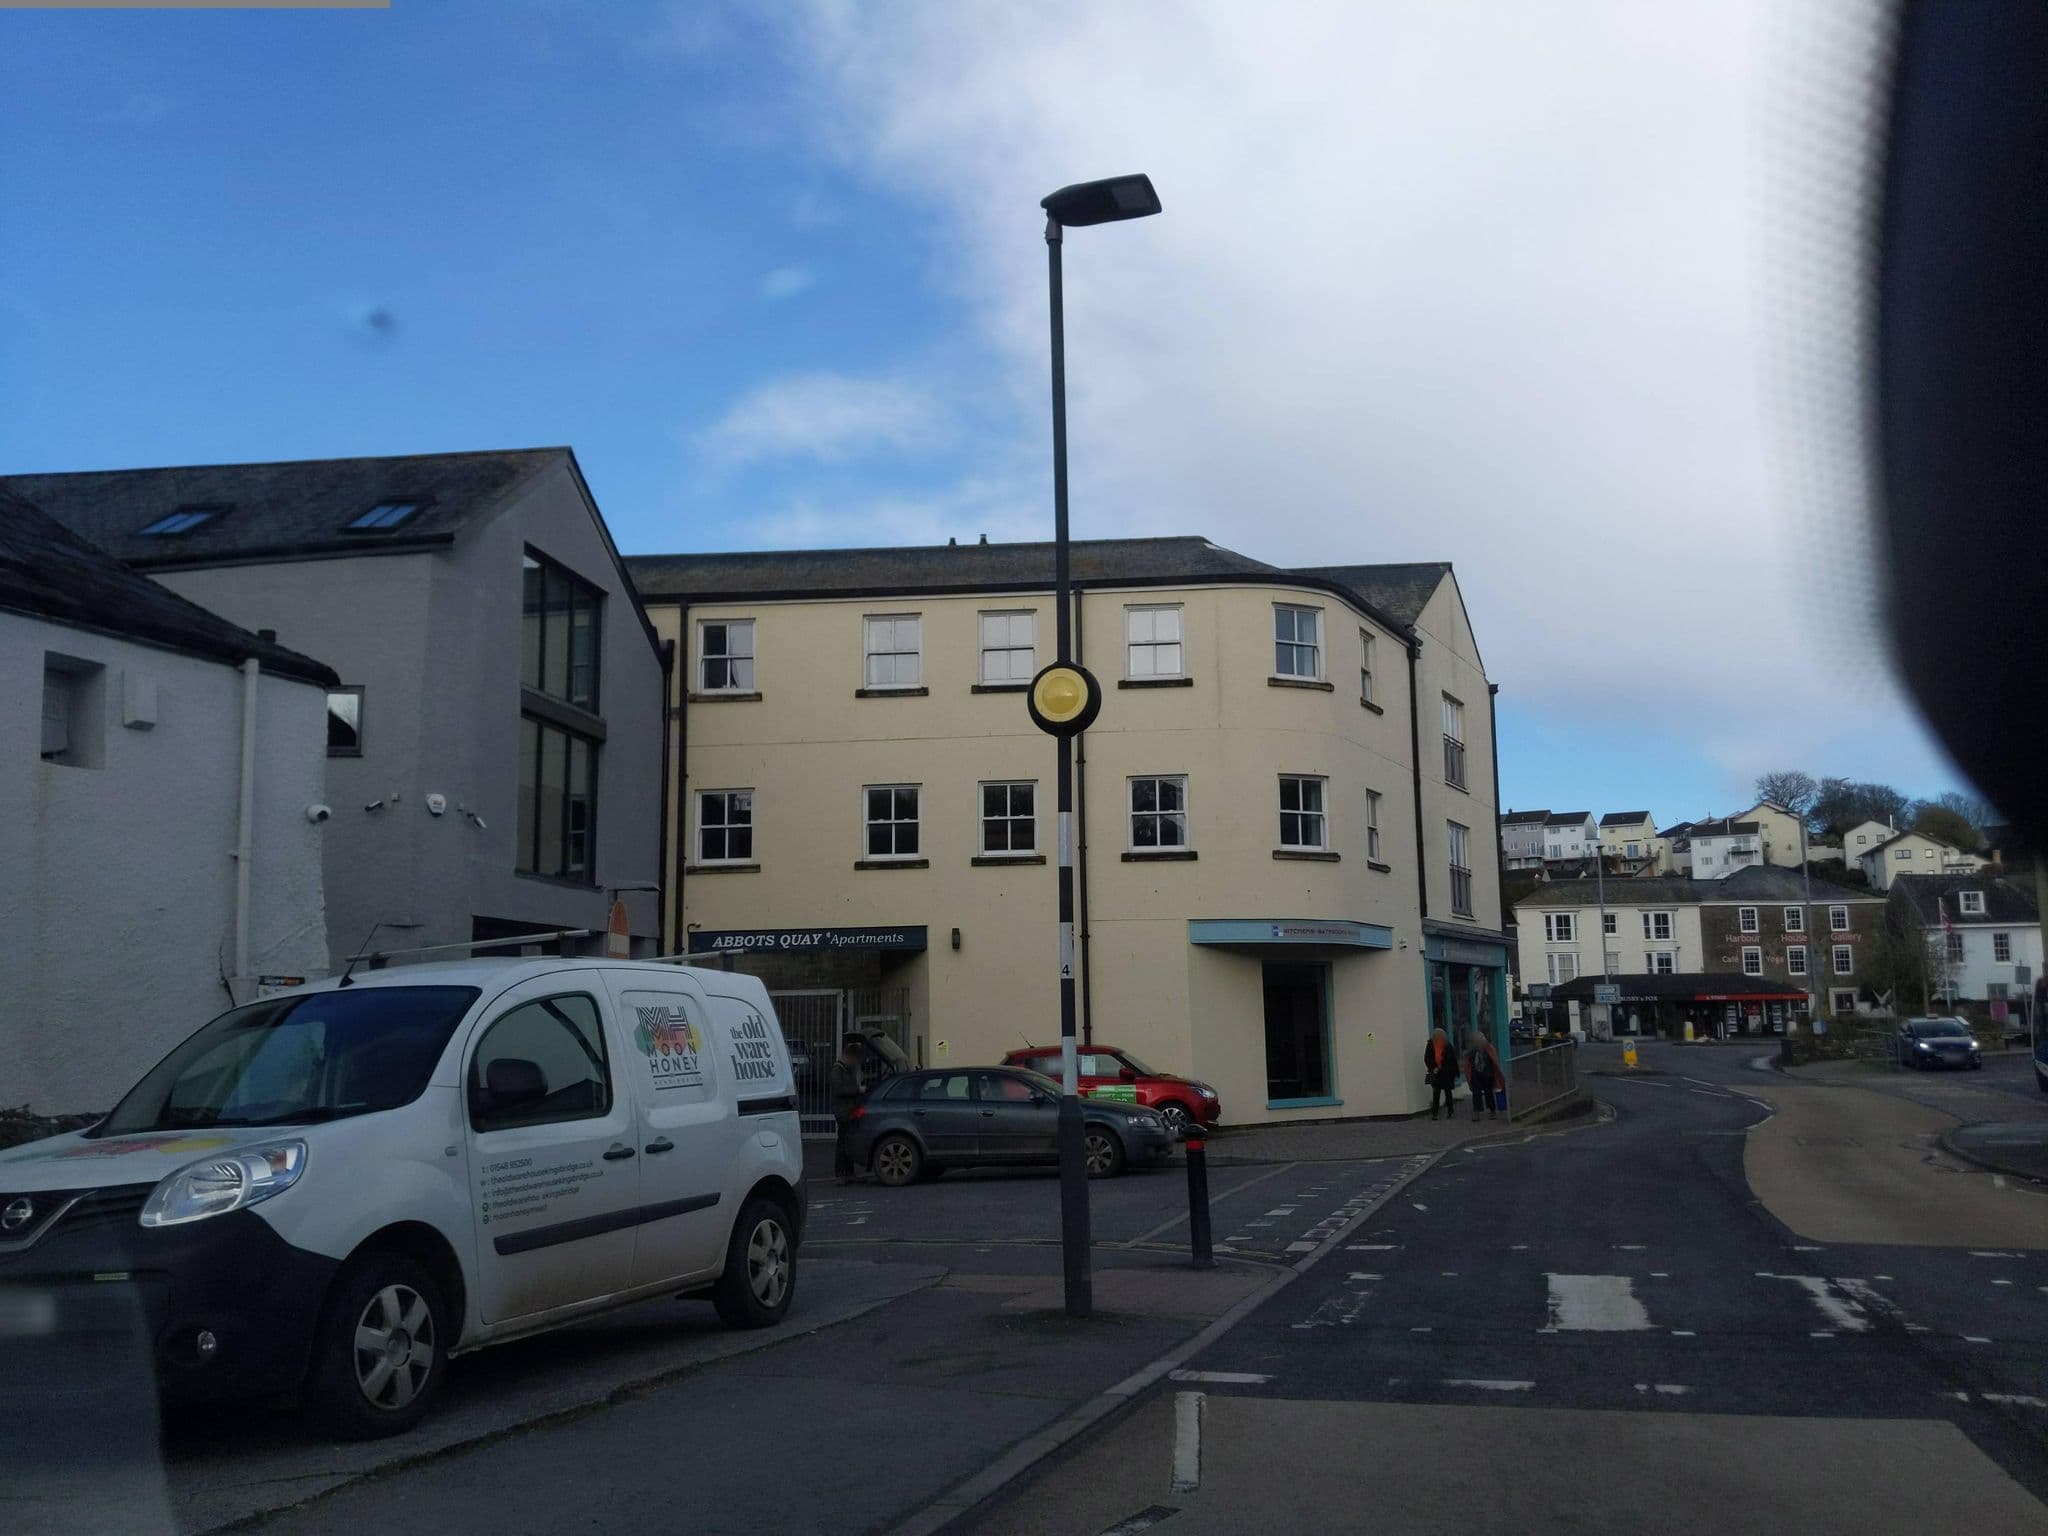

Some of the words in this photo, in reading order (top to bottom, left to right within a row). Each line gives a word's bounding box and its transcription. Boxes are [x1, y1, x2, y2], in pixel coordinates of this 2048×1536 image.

[712, 935, 775, 948] ABBOTS
[779, 933, 823, 947] QUAY
[1725, 933, 1761, 943] Harbour
[1781, 933, 1809, 943] House
[1830, 932, 1862, 943] Gallery
[1061, 964, 1071, 976] 4
[730, 1026, 743, 1039] the
[742, 1015, 767, 1039] old
[646, 1041, 697, 1058] MOON
[735, 1040, 772, 1060] ware
[650, 1056, 698, 1073] HONEY
[731, 1055, 776, 1080] house
